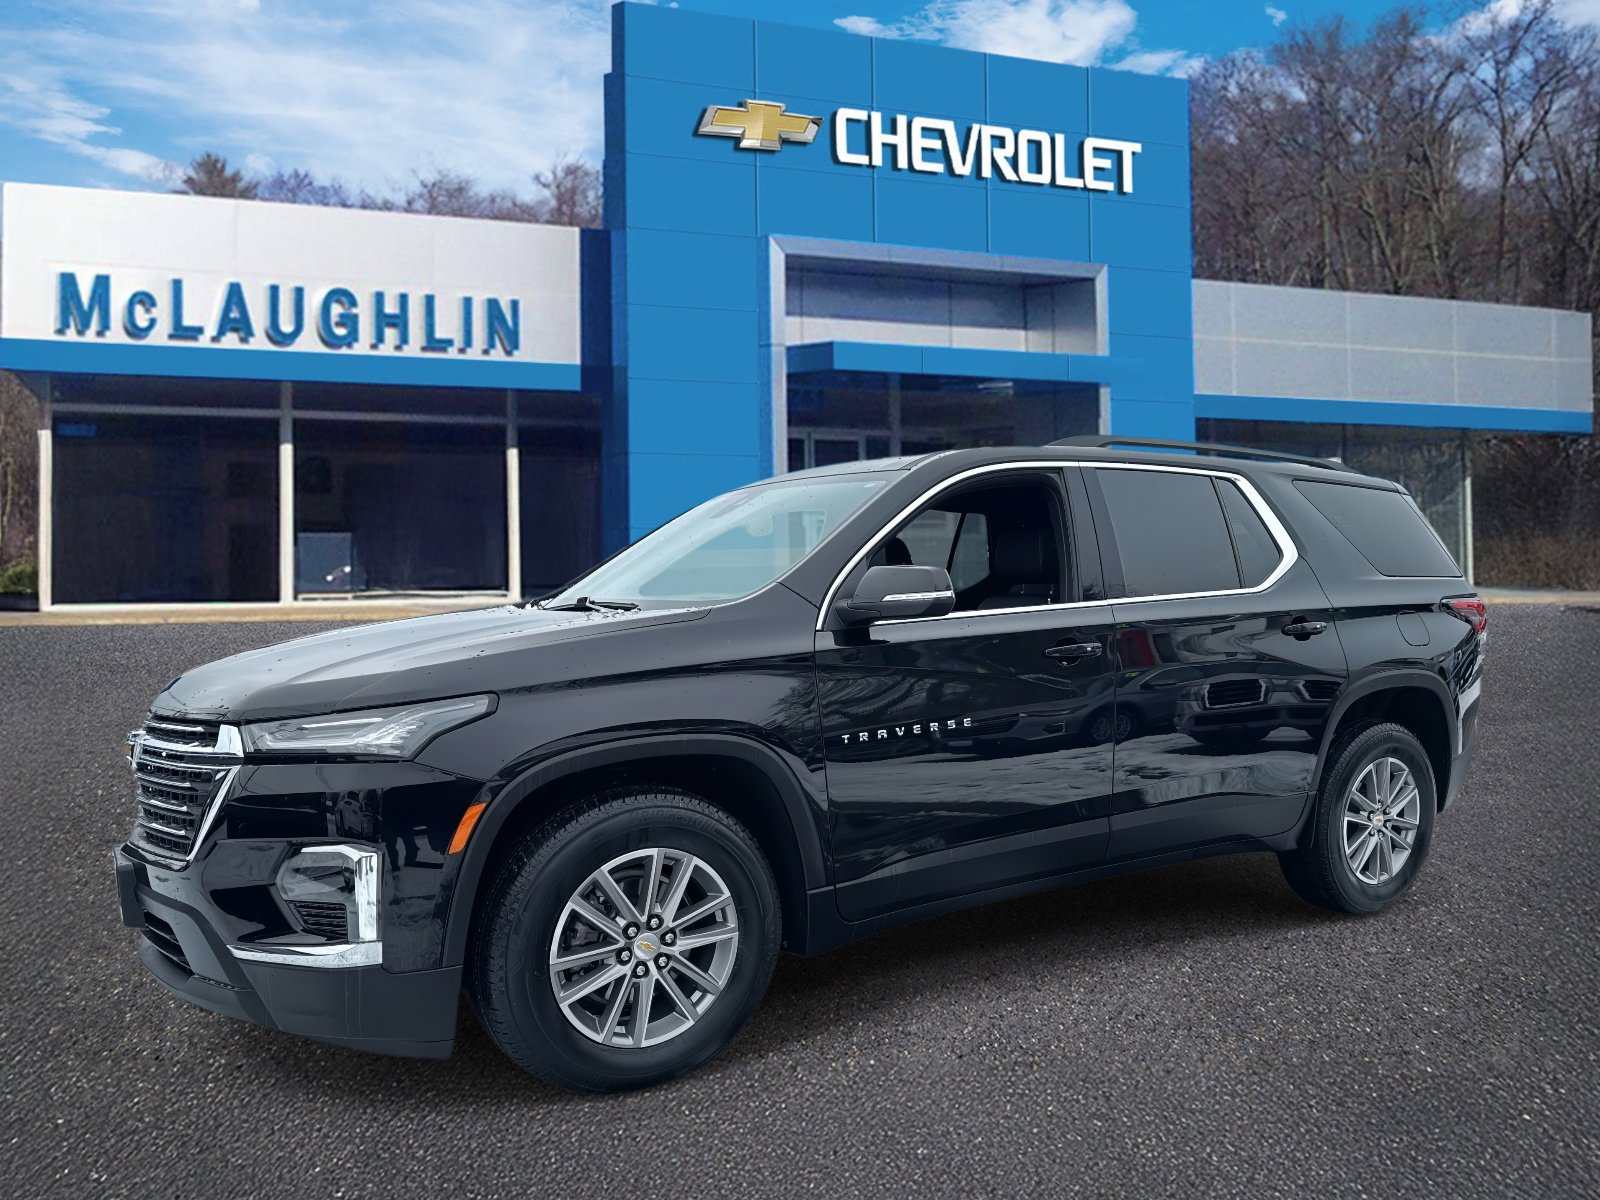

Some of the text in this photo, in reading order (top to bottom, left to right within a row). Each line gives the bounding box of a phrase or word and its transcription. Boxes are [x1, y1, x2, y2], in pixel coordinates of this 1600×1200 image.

[835, 108, 1142, 193] CHEVROLET
[56, 271, 521, 355] McLAUGHLIN
[841, 717, 972, 744] TRAVERSE
